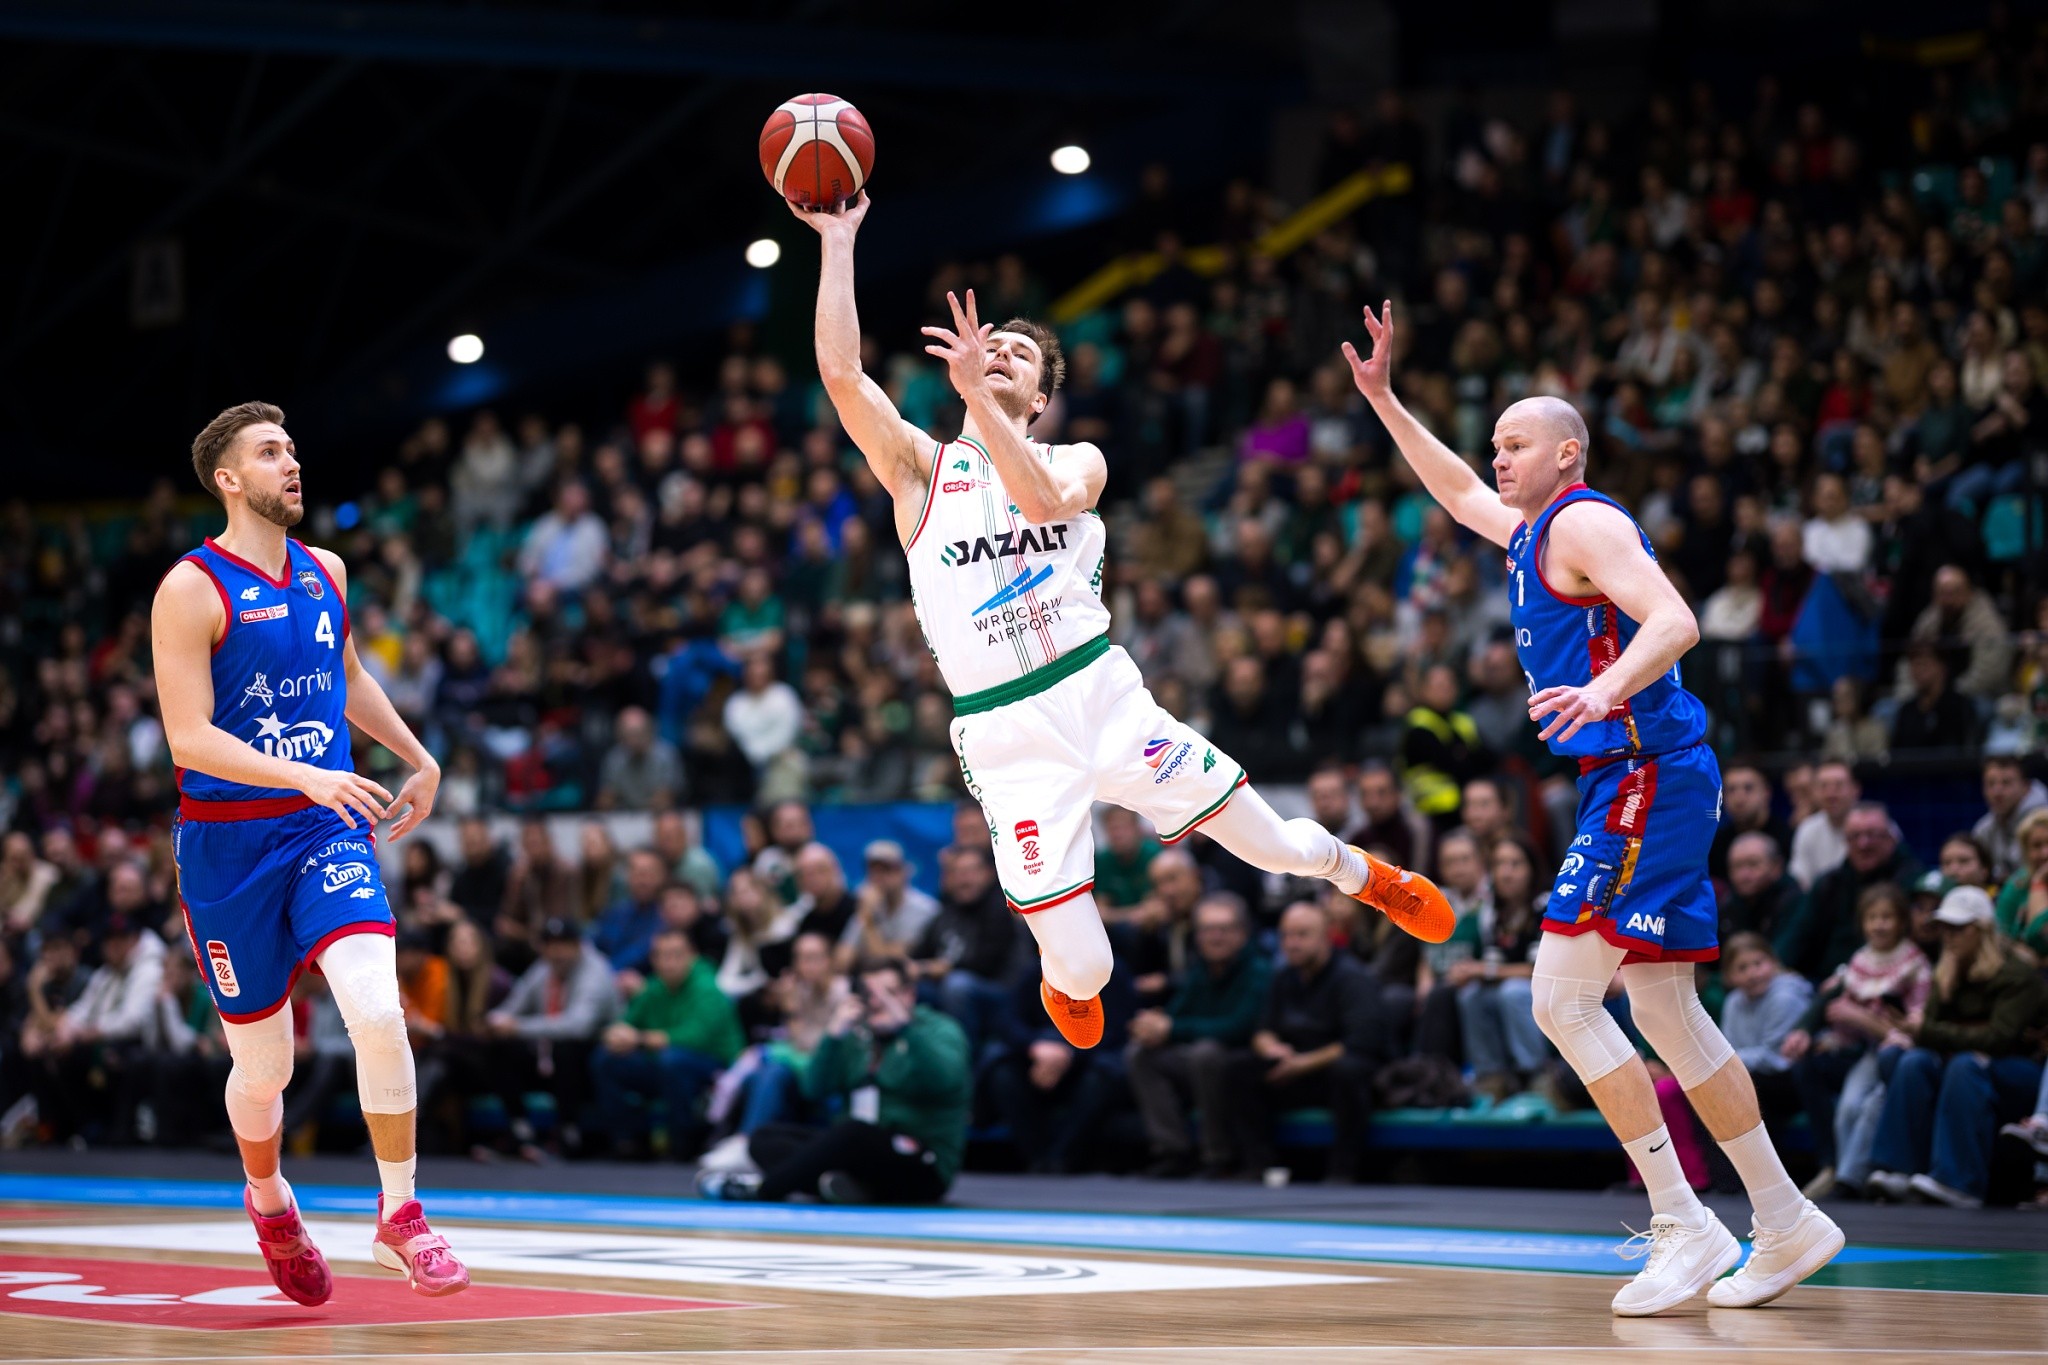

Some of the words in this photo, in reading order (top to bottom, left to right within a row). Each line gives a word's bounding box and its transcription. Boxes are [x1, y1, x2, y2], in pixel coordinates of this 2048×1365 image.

[953, 523, 1068, 566] BAZALT
[240, 586, 260, 601] 4F
[243, 610, 268, 620] ORLEN
[315, 611, 336, 649] 4
[988, 610, 1062, 647] AIRPORT
[1155, 741, 1193, 784] aquapark
[1204, 747, 1217, 774] 4F
[1016, 825, 1037, 835] ORLEN
[1023, 860, 1044, 871] Basket
[1028, 867, 1041, 875] Liga
[330, 866, 364, 886] LOTTO
[349, 886, 376, 899] 4F
[1557, 882, 1578, 897] 4F
